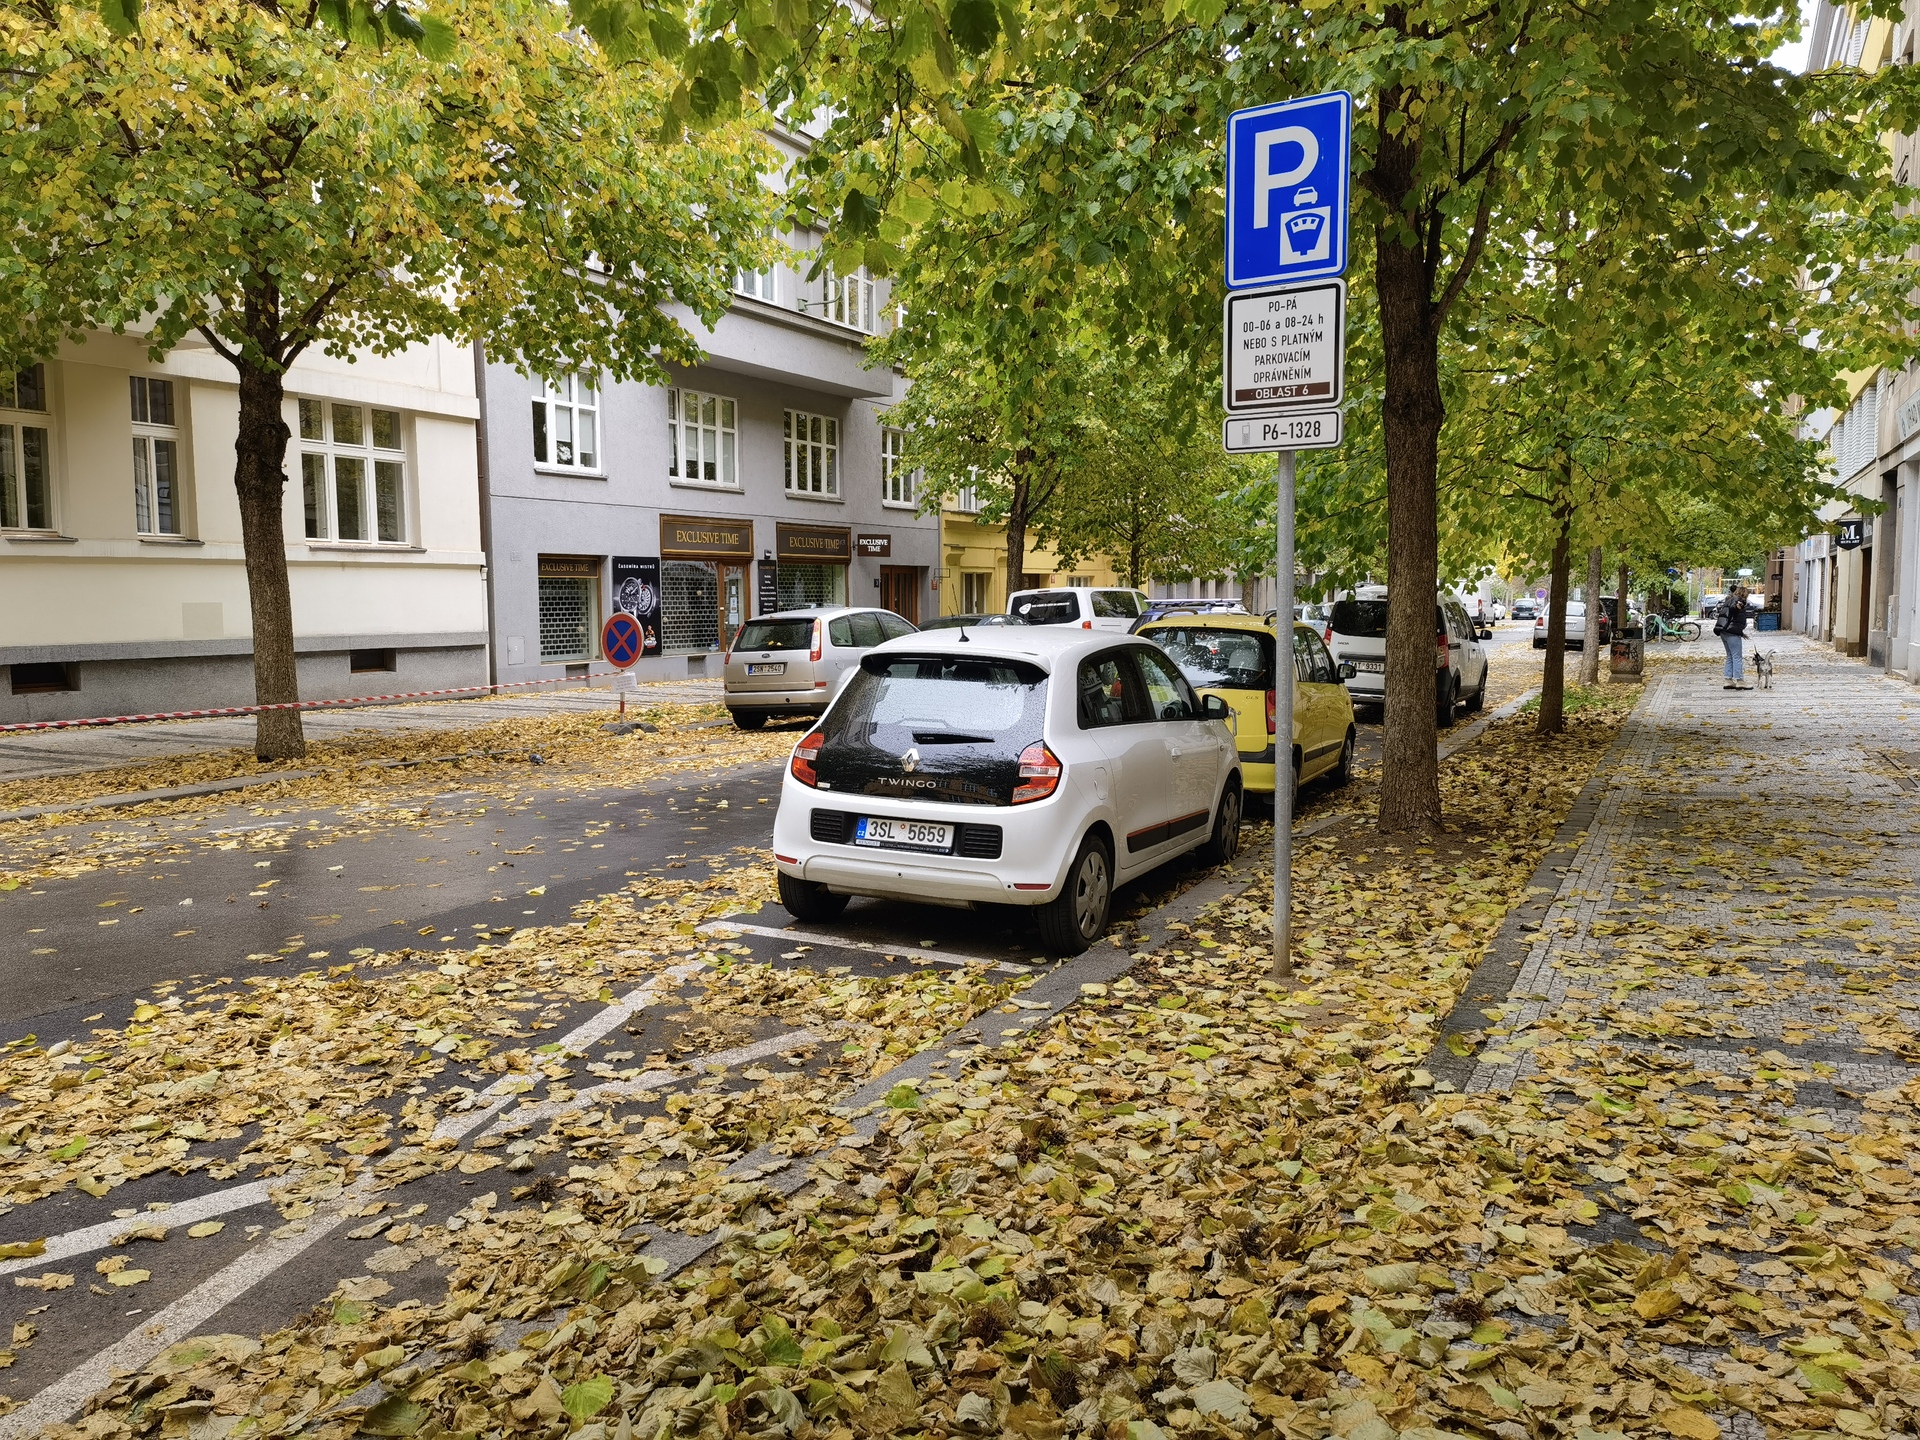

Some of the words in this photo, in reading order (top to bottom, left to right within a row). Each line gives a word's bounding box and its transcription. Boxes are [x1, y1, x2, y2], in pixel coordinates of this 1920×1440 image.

[1254, 126, 1319, 230] P
[1268, 296, 1298, 312] PO-PÁ
[1243, 320, 1270, 332] 00-06
[1275, 320, 1281, 330] a
[1285, 314, 1314, 328] 08-24
[1318, 314, 1324, 324] h
[1243, 338, 1267, 350] NEBO
[1271, 336, 1277, 347] S
[1281, 329, 1323, 346] PLATNÝM
[1254, 348, 1310, 366] PARKOVACÍM
[1254, 366, 1312, 383] OPRÁVNĚNÍM
[1256, 386, 1298, 399] OBLAST
[1302, 385, 1309, 395] 6
[1263, 420, 1321, 441] P6-1328
[676, 530, 720, 544] EXCLUSIVE
[720, 532, 739, 544] TIME
[789, 536, 824, 549] EXCLUSIVE
[824, 538, 839, 549] TIME
[541, 562, 574, 572] EXCLUSIVE
[575, 564, 589, 572] TIME
[878, 777, 936, 789] TWINGO
[869, 820, 895, 839] 3SL
[908, 824, 946, 844] 5659
